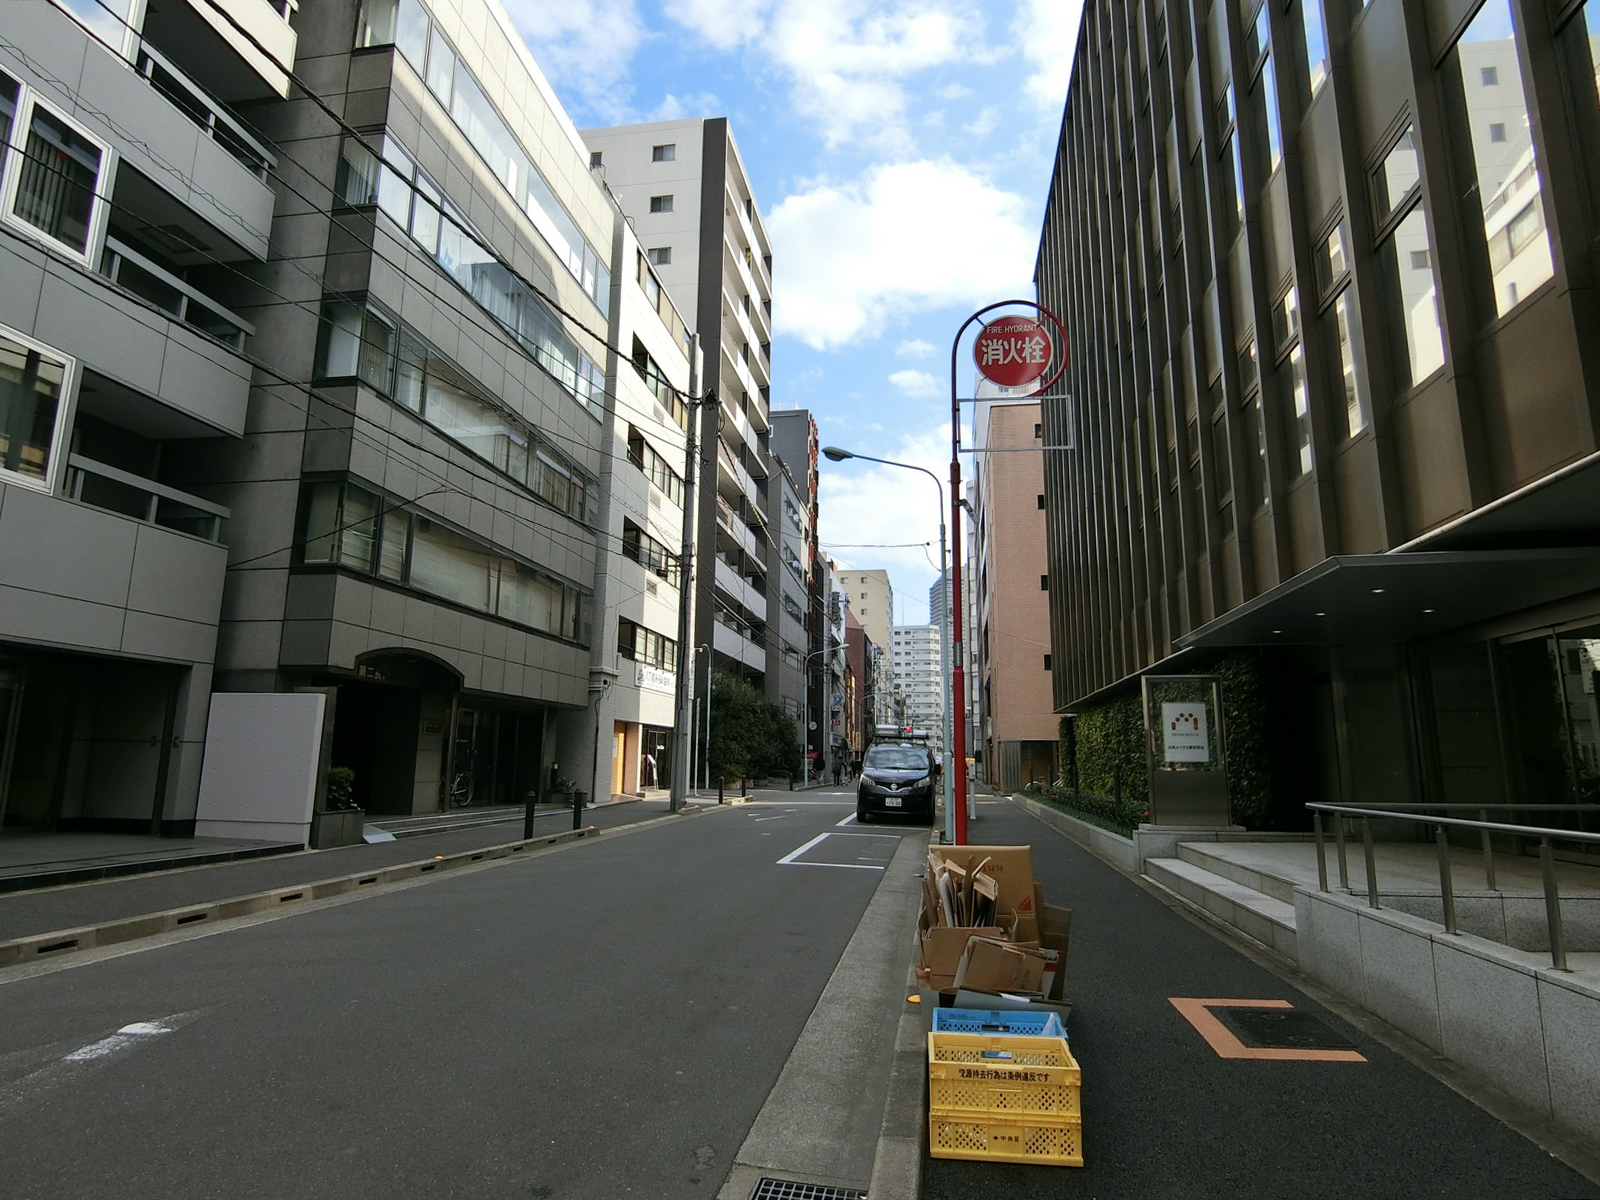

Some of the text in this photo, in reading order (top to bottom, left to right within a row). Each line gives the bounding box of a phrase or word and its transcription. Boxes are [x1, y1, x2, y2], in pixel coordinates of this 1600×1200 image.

[986, 324, 1038, 334] FIRE HYDRANT
[981, 336, 1045, 366] 消火栓
